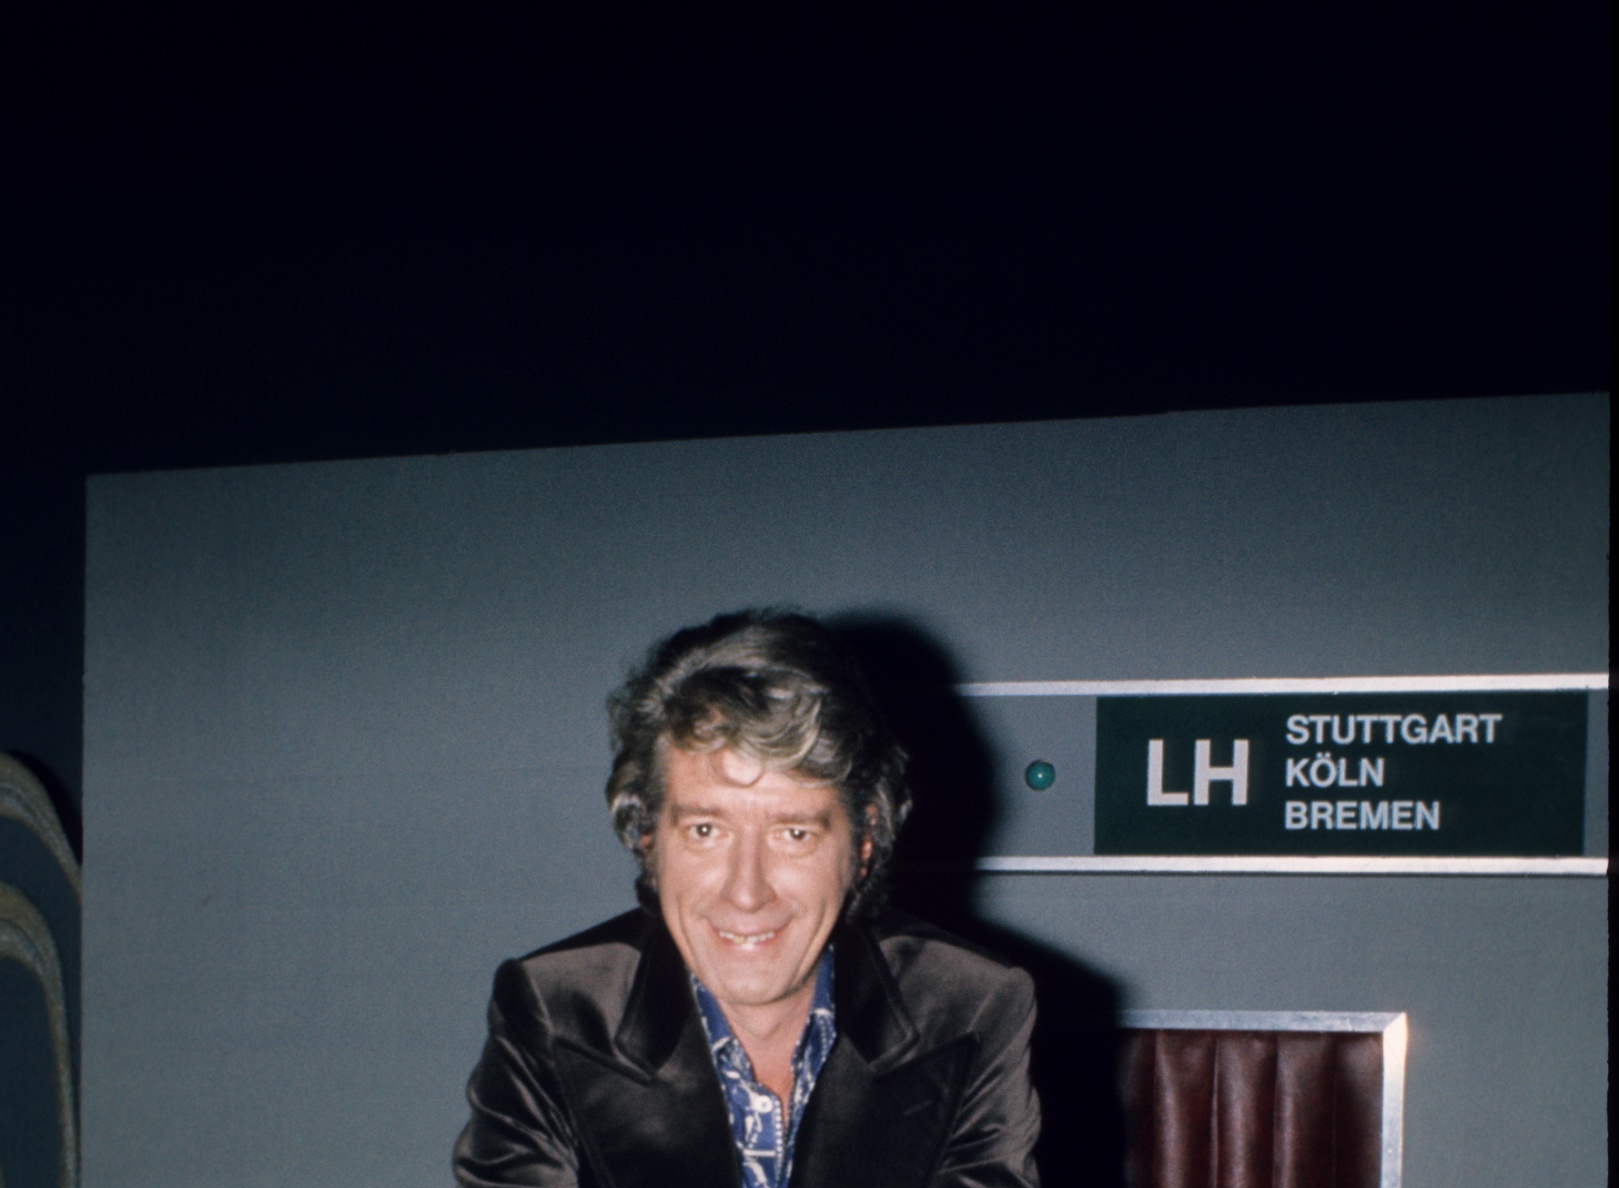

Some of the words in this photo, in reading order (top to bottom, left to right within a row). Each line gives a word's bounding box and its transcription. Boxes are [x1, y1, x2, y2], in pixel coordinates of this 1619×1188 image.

[1285, 713, 1503, 745] STUTTGART
[1146, 738, 1250, 807] LH
[1285, 752, 1386, 788] KÖLN
[1284, 800, 1441, 830] BREMEN
